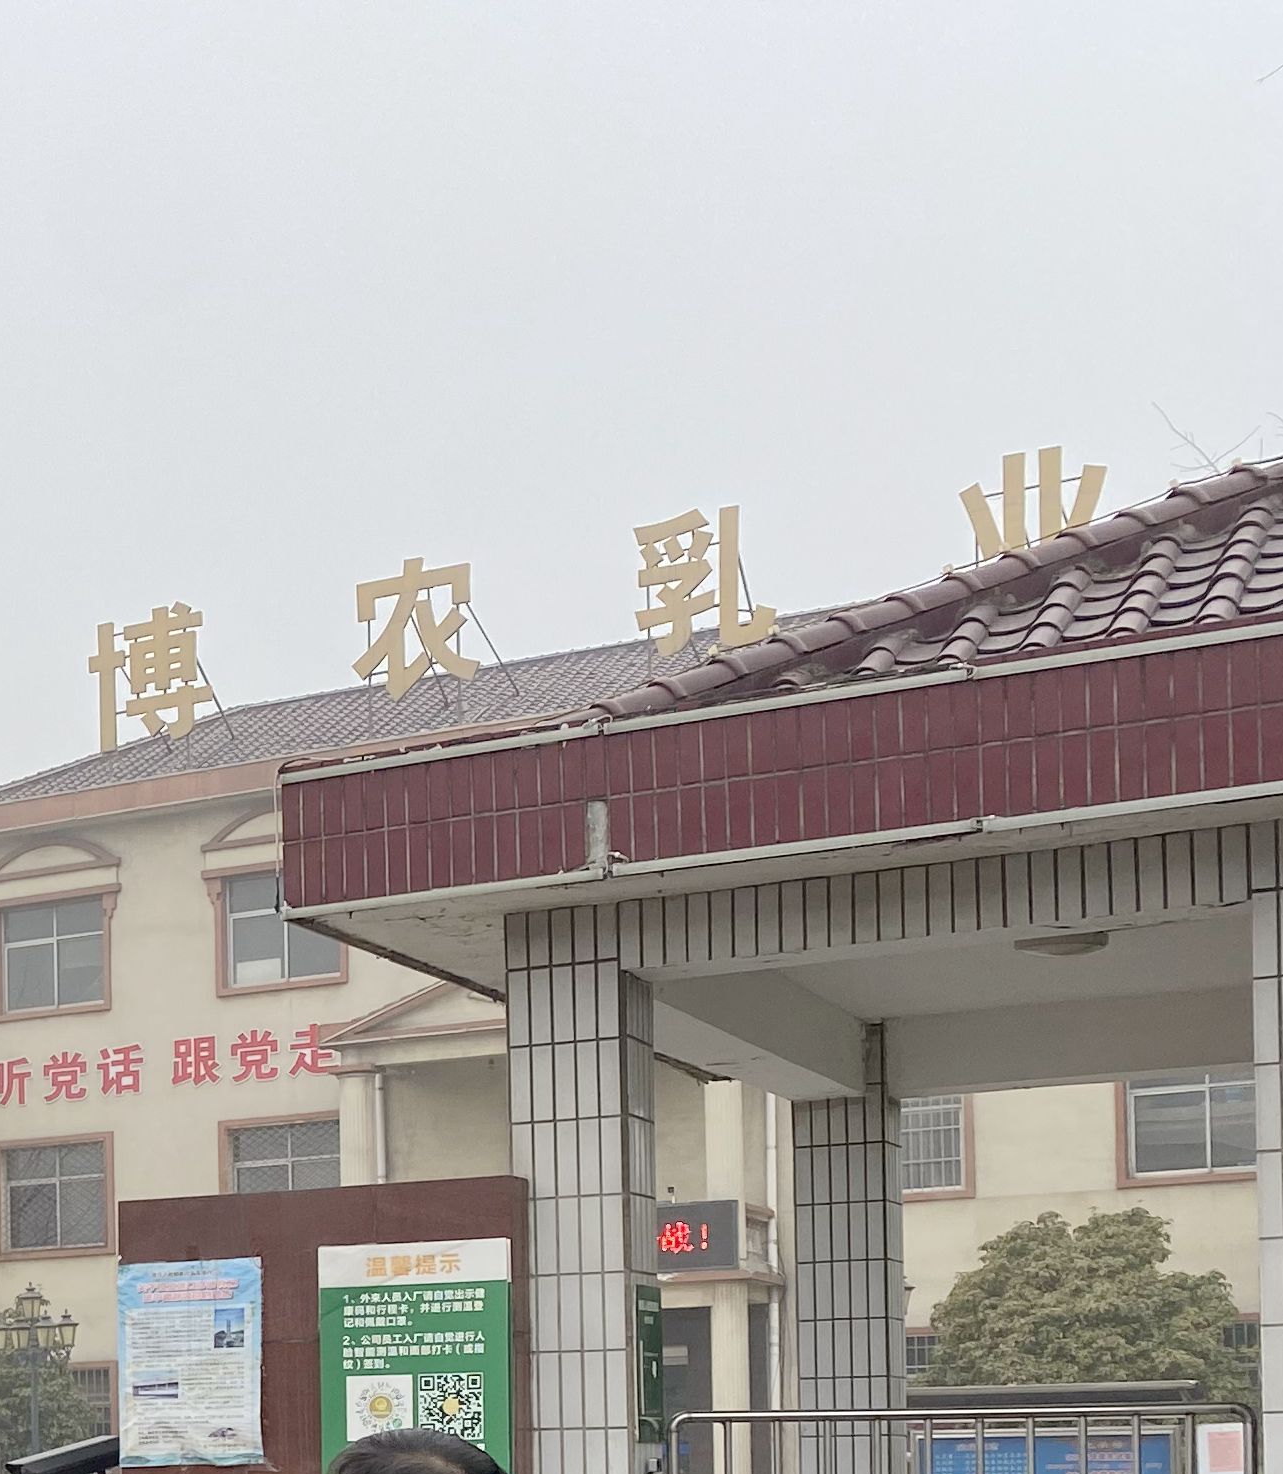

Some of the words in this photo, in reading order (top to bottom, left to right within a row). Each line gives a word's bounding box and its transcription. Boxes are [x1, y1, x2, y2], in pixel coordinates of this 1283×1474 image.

[87, 446, 1108, 755] 博农乳业
[171, 1022, 341, 1087] 跟党走
[366, 1252, 461, 1278] 温馨提示
